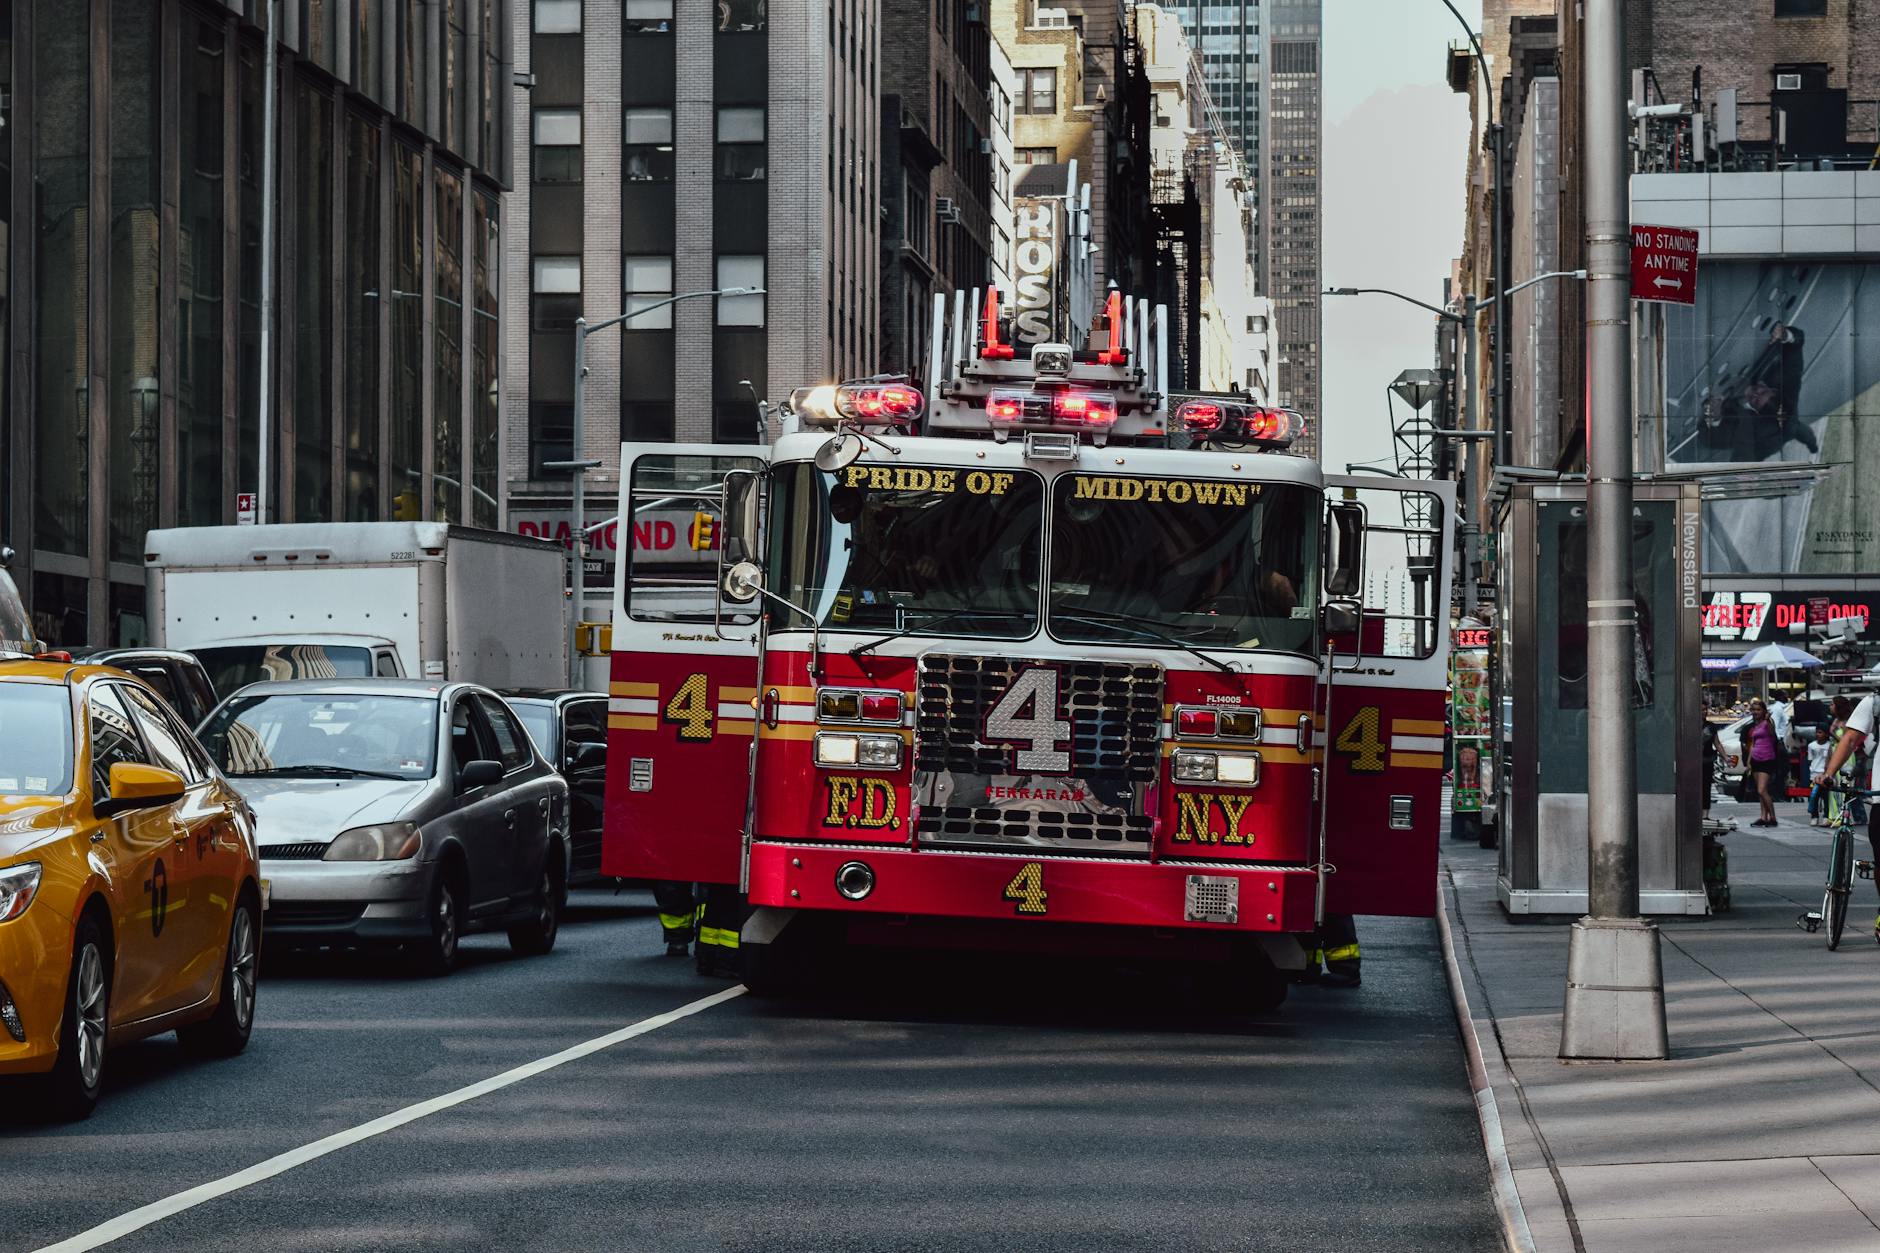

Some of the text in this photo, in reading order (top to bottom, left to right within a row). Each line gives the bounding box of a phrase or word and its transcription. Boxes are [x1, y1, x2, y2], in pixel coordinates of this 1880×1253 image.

[1635, 232, 1696, 253] NO STANDING
[1644, 254, 1689, 272] ANYTIME
[1016, 205, 1053, 344] ROSS
[965, 471, 1014, 495] OF
[391, 551, 415, 560] 522281
[1683, 513, 1699, 608] Newsstand
[1701, 603, 1764, 628] STREET
[1776, 604, 1869, 628] DIAOND
[1703, 591, 1772, 641] 47
[666, 673, 713, 739] 4
[986, 669, 1070, 771] 4
[1206, 695, 1241, 703] FL14005
[1335, 707, 1386, 771] 4
[826, 776, 900, 828] F.D.
[1176, 793, 1254, 844] N.Y.
[1006, 863, 1047, 912] 4
